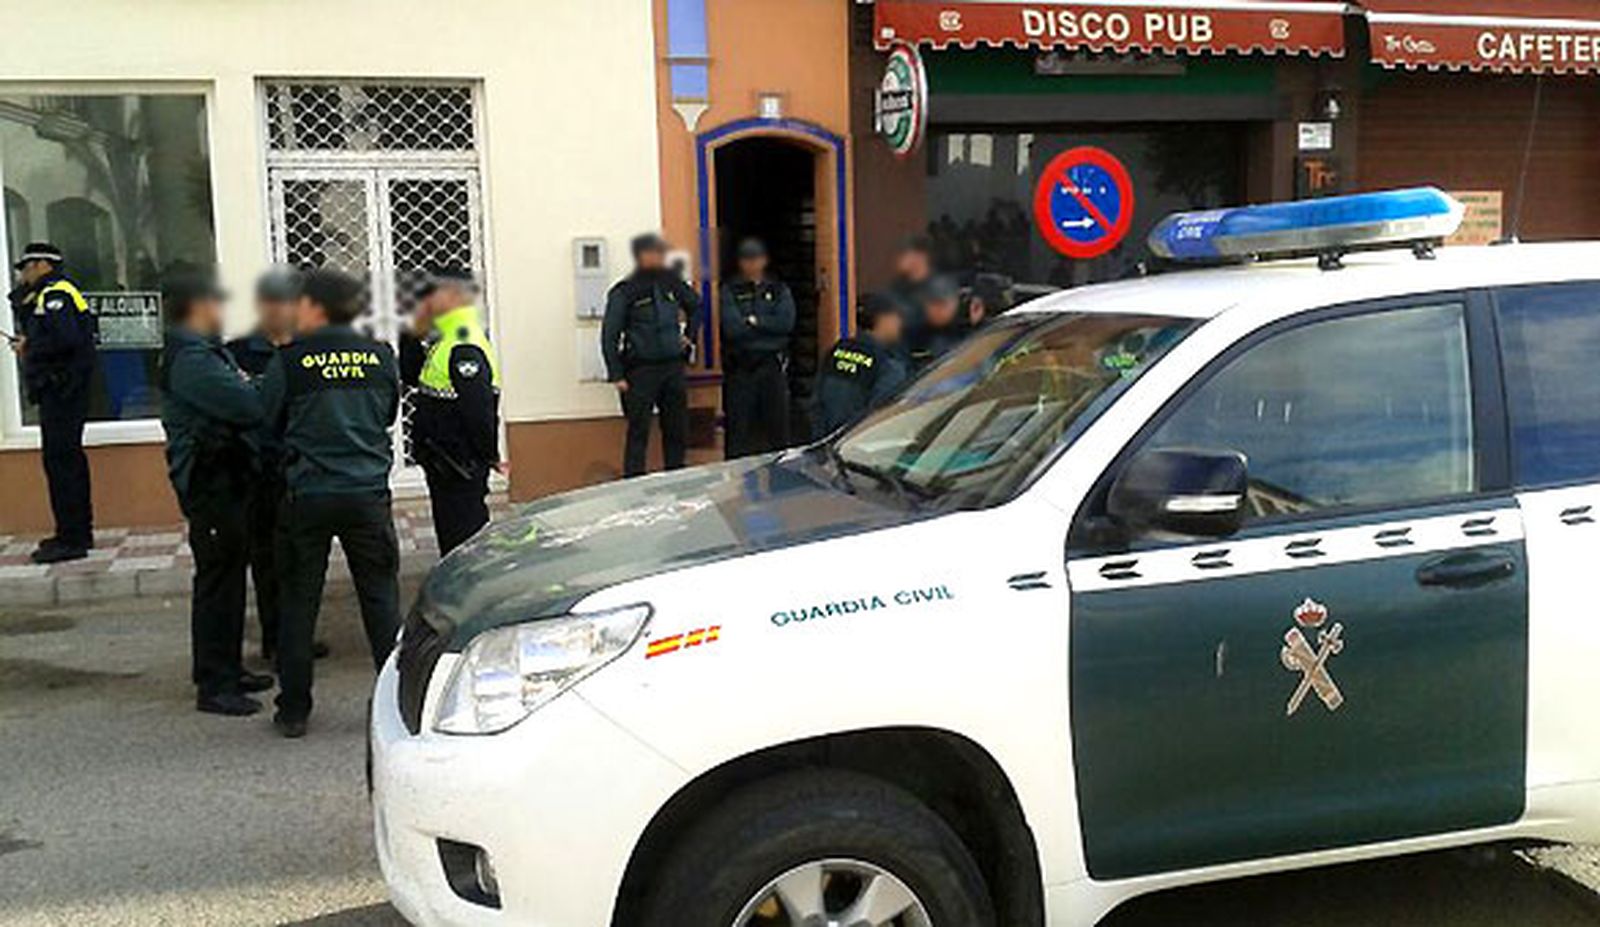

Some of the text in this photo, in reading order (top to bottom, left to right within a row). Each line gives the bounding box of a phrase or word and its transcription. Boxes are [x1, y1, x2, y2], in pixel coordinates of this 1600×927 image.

[1022, 9, 1213, 42] DISCO PUB
[301, 352, 380, 368] GUARDIA
[321, 365, 365, 379] CIVIL
[770, 584, 955, 627] GUARDIA CIVIL
